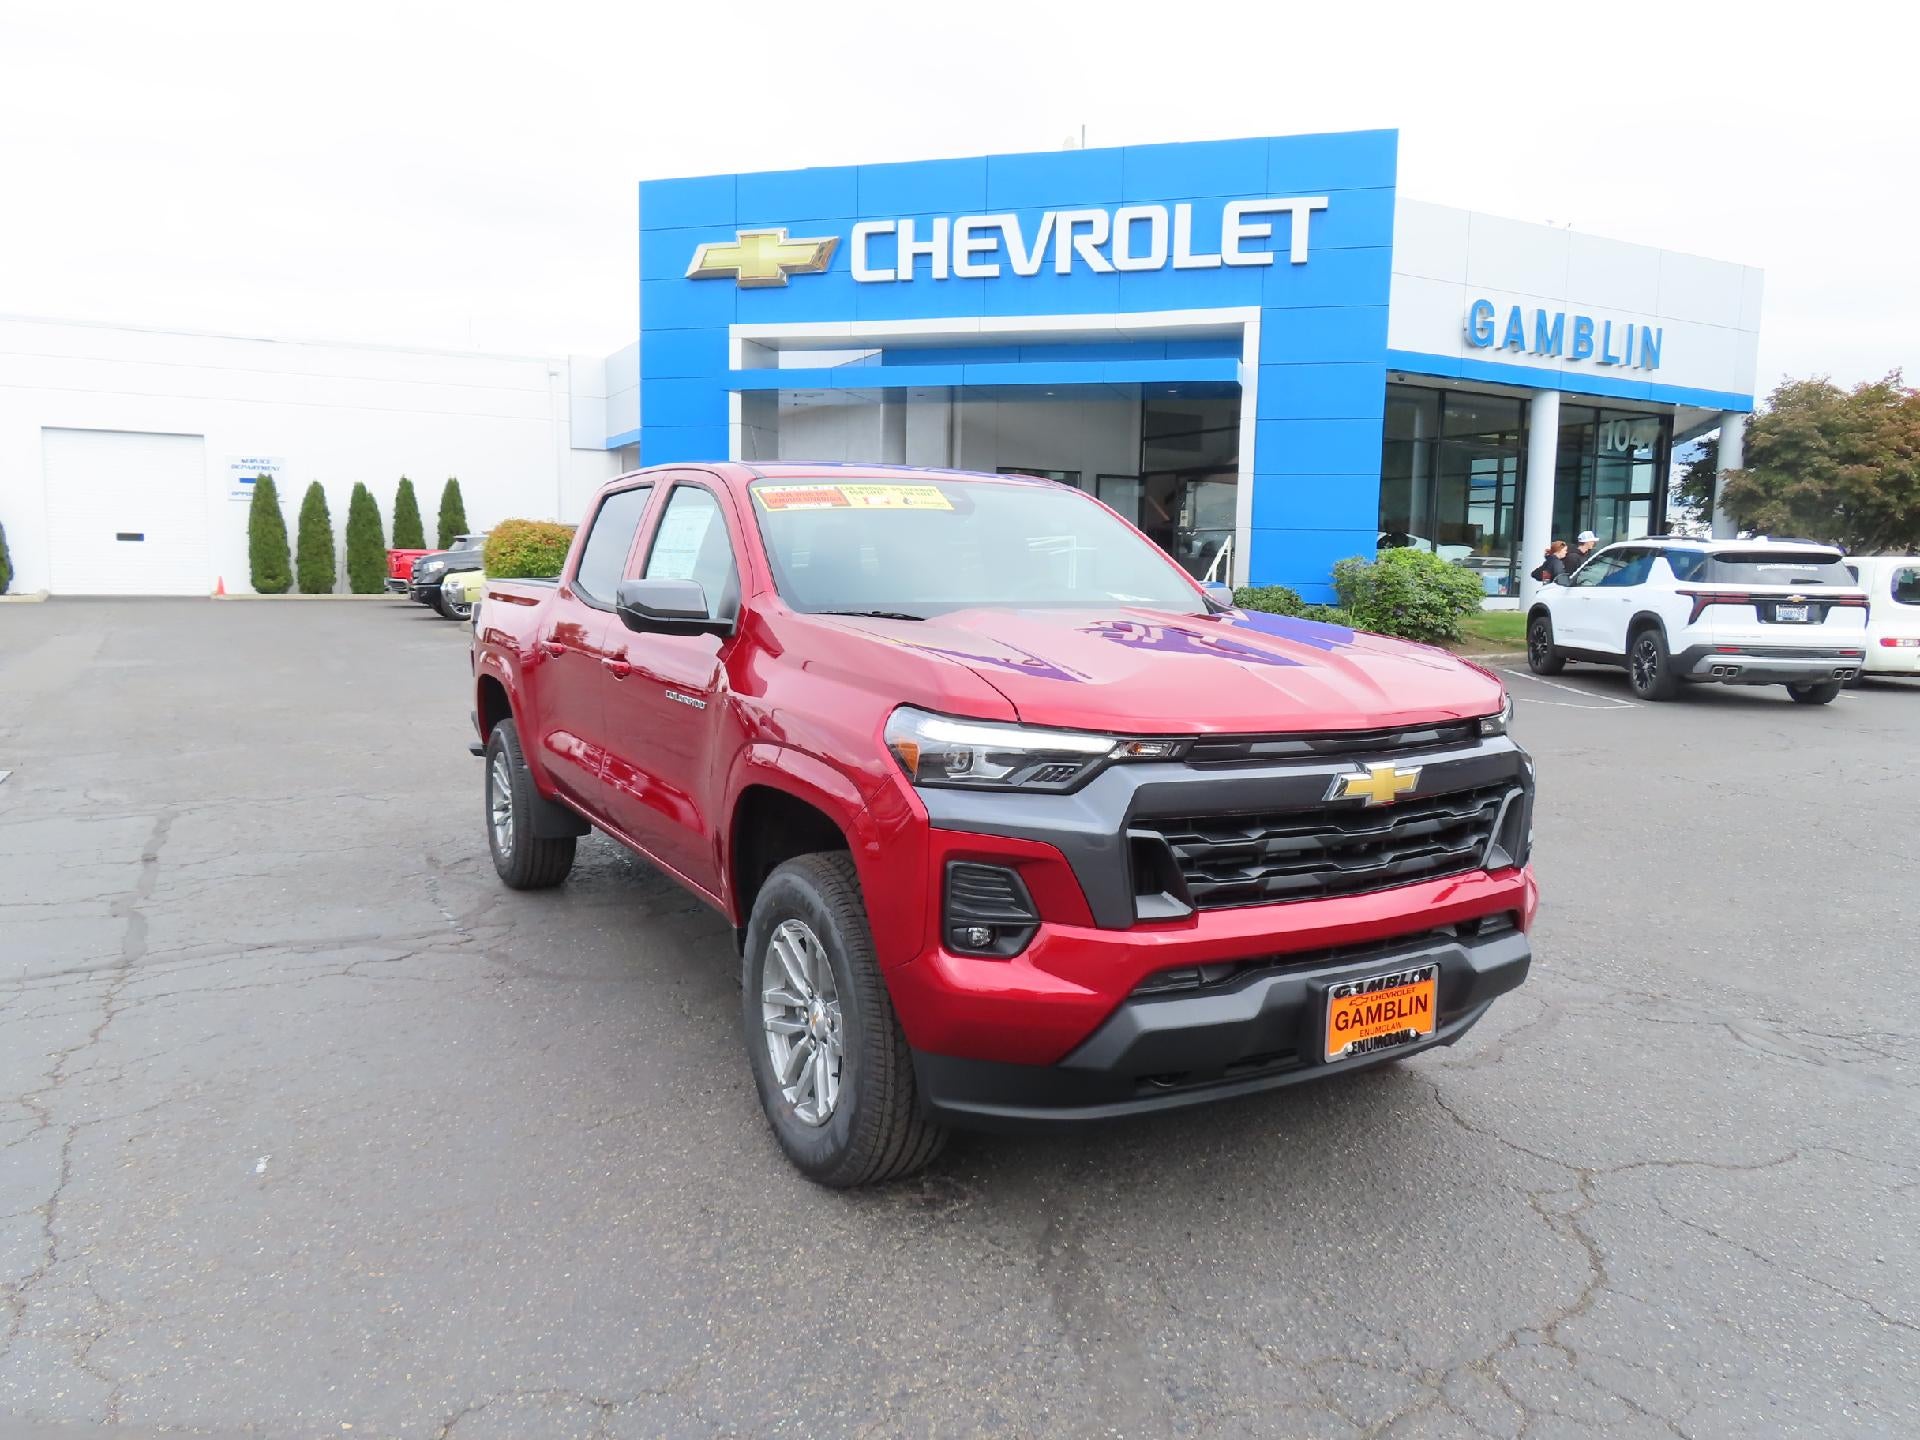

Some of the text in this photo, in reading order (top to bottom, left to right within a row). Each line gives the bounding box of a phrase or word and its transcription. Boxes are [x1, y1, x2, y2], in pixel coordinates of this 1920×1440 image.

[851, 196, 1329, 283] CHEVROLET
[1466, 298, 1663, 370] GAMBLIN
[1333, 966, 1434, 999] GAMBLIN
[1370, 986, 1417, 1002] CHEVROLET
[1334, 993, 1428, 1032] GAMBLIN
[1359, 1021, 1402, 1037] ENUMCLAW
